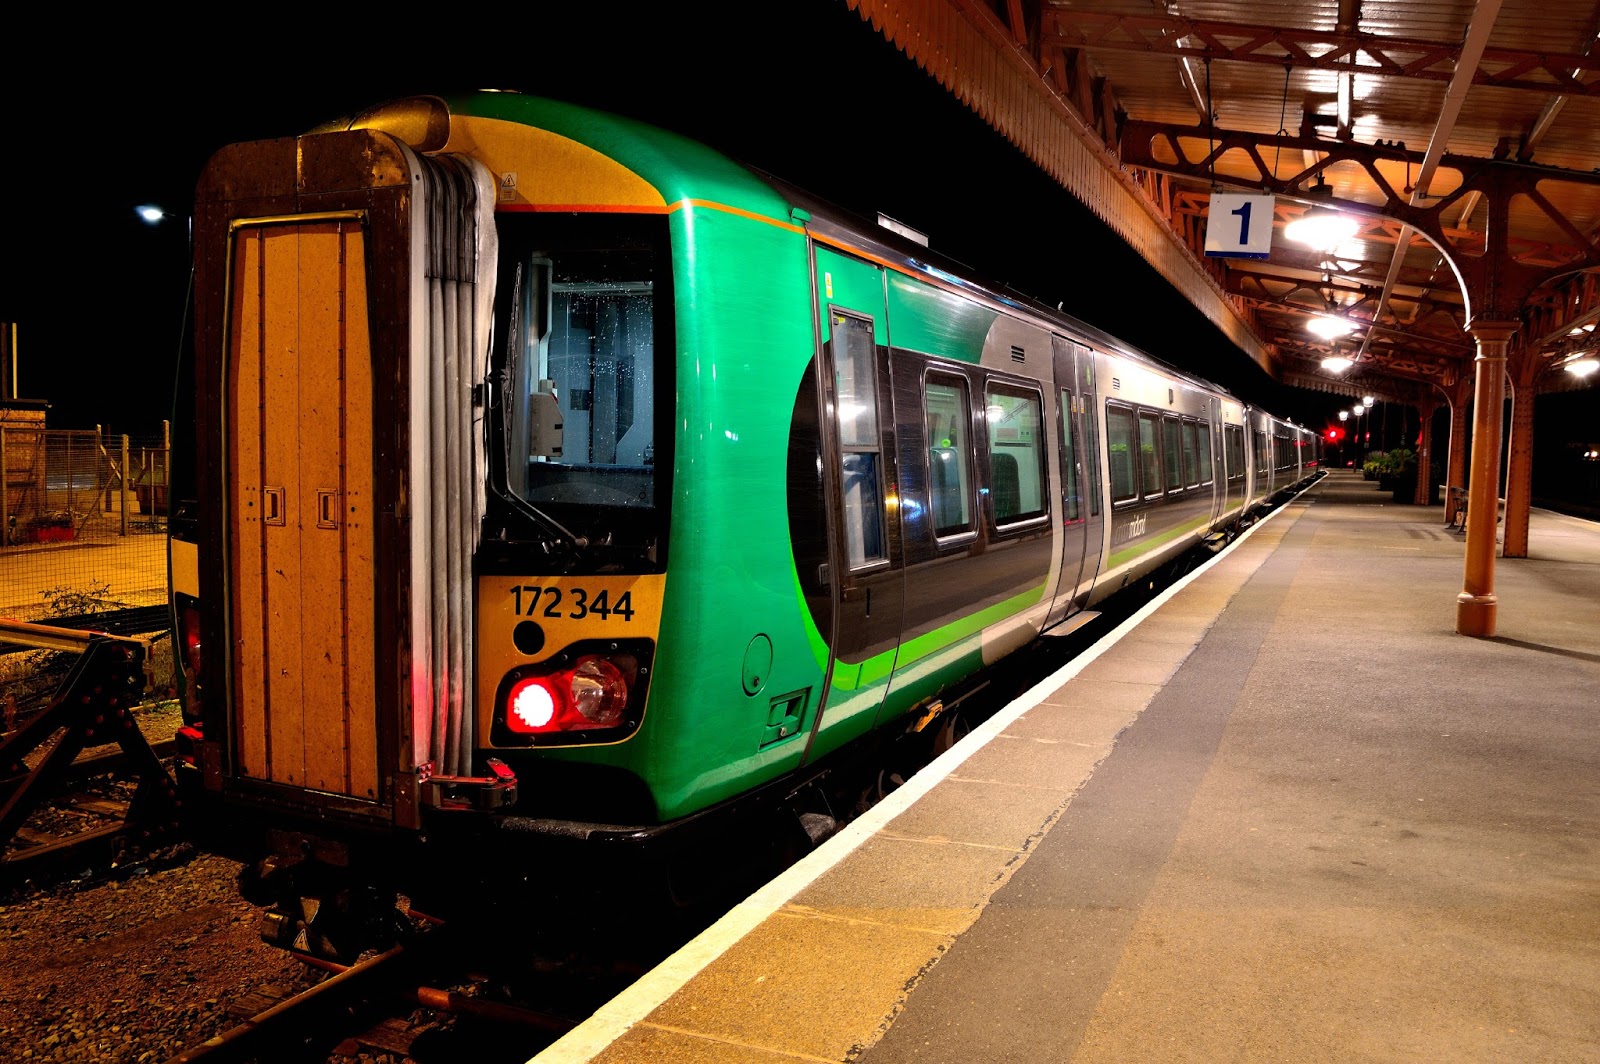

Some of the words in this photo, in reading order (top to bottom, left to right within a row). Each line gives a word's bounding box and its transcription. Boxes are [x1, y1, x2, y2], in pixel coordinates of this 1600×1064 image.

[1231, 202, 1252, 245] 1
[510, 585, 562, 618] 172
[569, 588, 635, 622] 344
